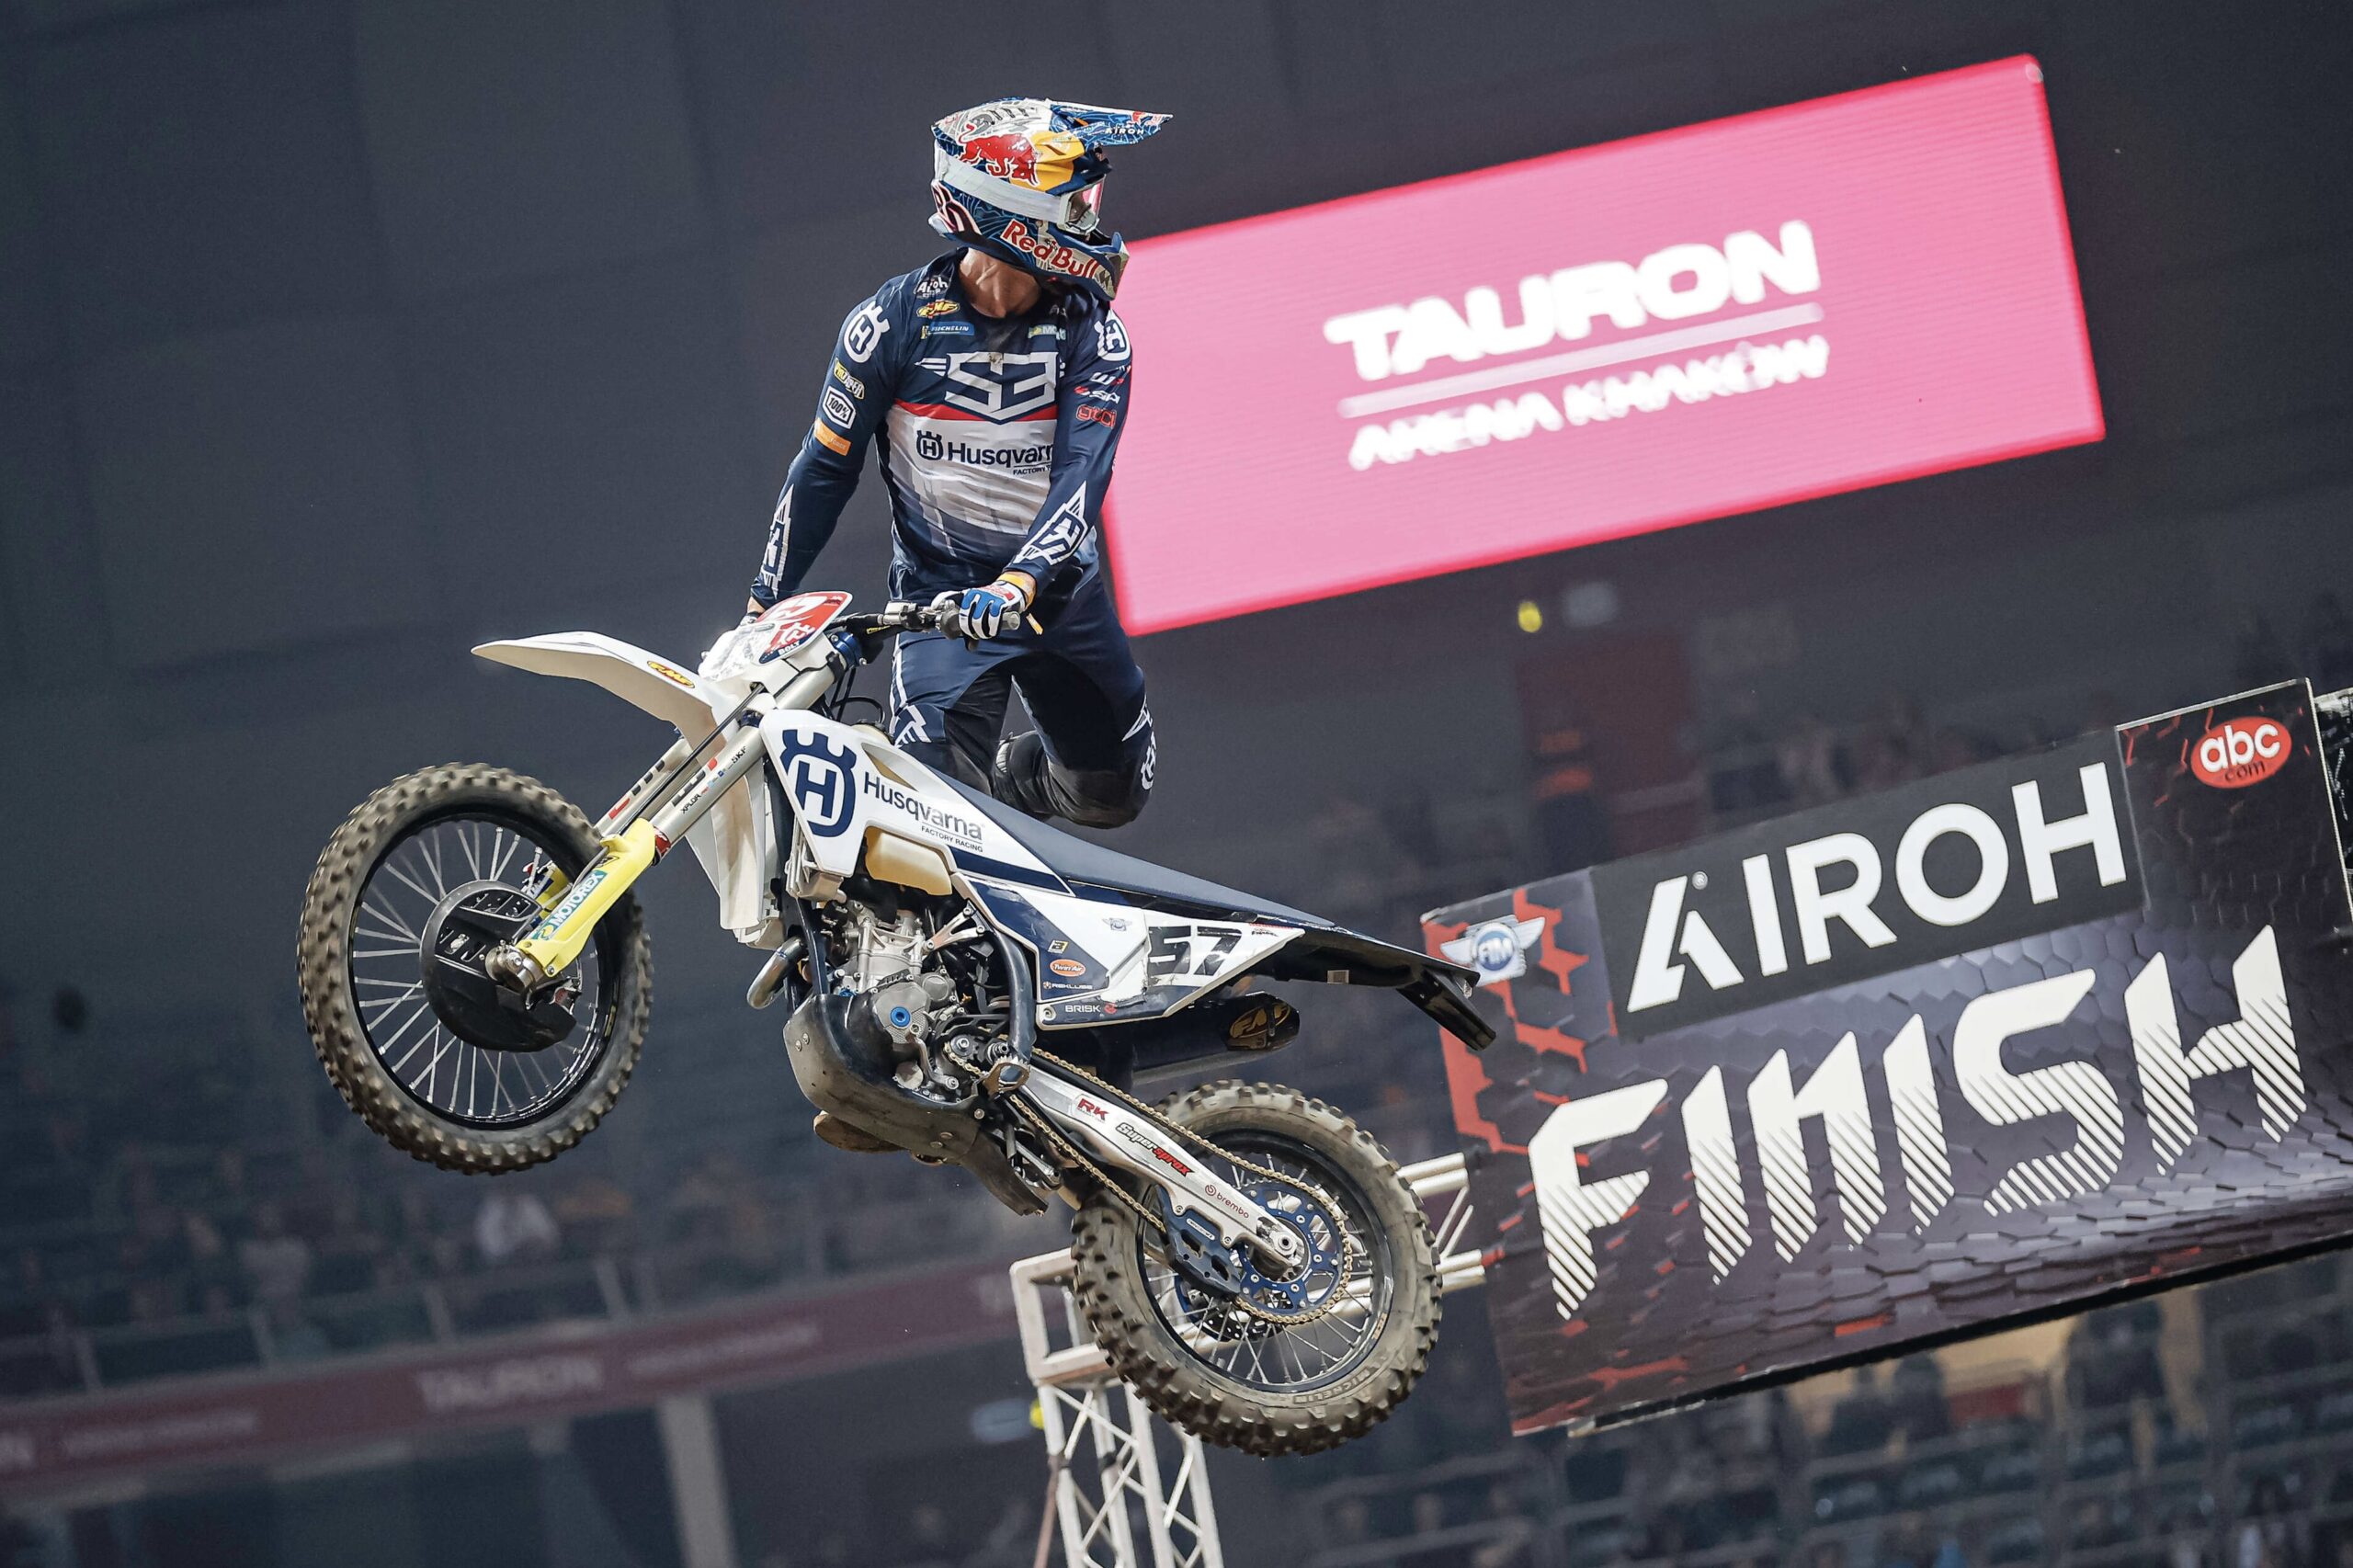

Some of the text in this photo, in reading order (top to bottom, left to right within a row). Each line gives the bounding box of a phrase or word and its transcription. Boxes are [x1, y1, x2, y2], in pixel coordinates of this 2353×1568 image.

[1001, 219, 1100, 278] Red Bull
[1324, 220, 1821, 381] TAURON
[829, 397, 848, 418] 100%
[1348, 392, 1563, 471] ARENA
[948, 442, 1053, 468] Husqvarn
[1013, 467, 1045, 475] FACTORY
[2200, 724, 2280, 772] abc
[2224, 760, 2266, 781] com
[863, 770, 983, 841] Husqvarna
[922, 825, 983, 853] FACTORY RACING
[548, 873, 604, 926] MOTOREX
[1627, 762, 2126, 1012] AIROH
[1053, 963, 1072, 971] Twin
[1148, 925, 1242, 977] 57
[1064, 1005, 1101, 1013] BRISK
[1077, 1098, 1109, 1120] RK
[1528, 925, 2307, 1320] FINISH
[1115, 1122, 1195, 1176] Supersprox
[1216, 1193, 1250, 1219] brembo
[1293, 1368, 1371, 1403] MICHELIN
